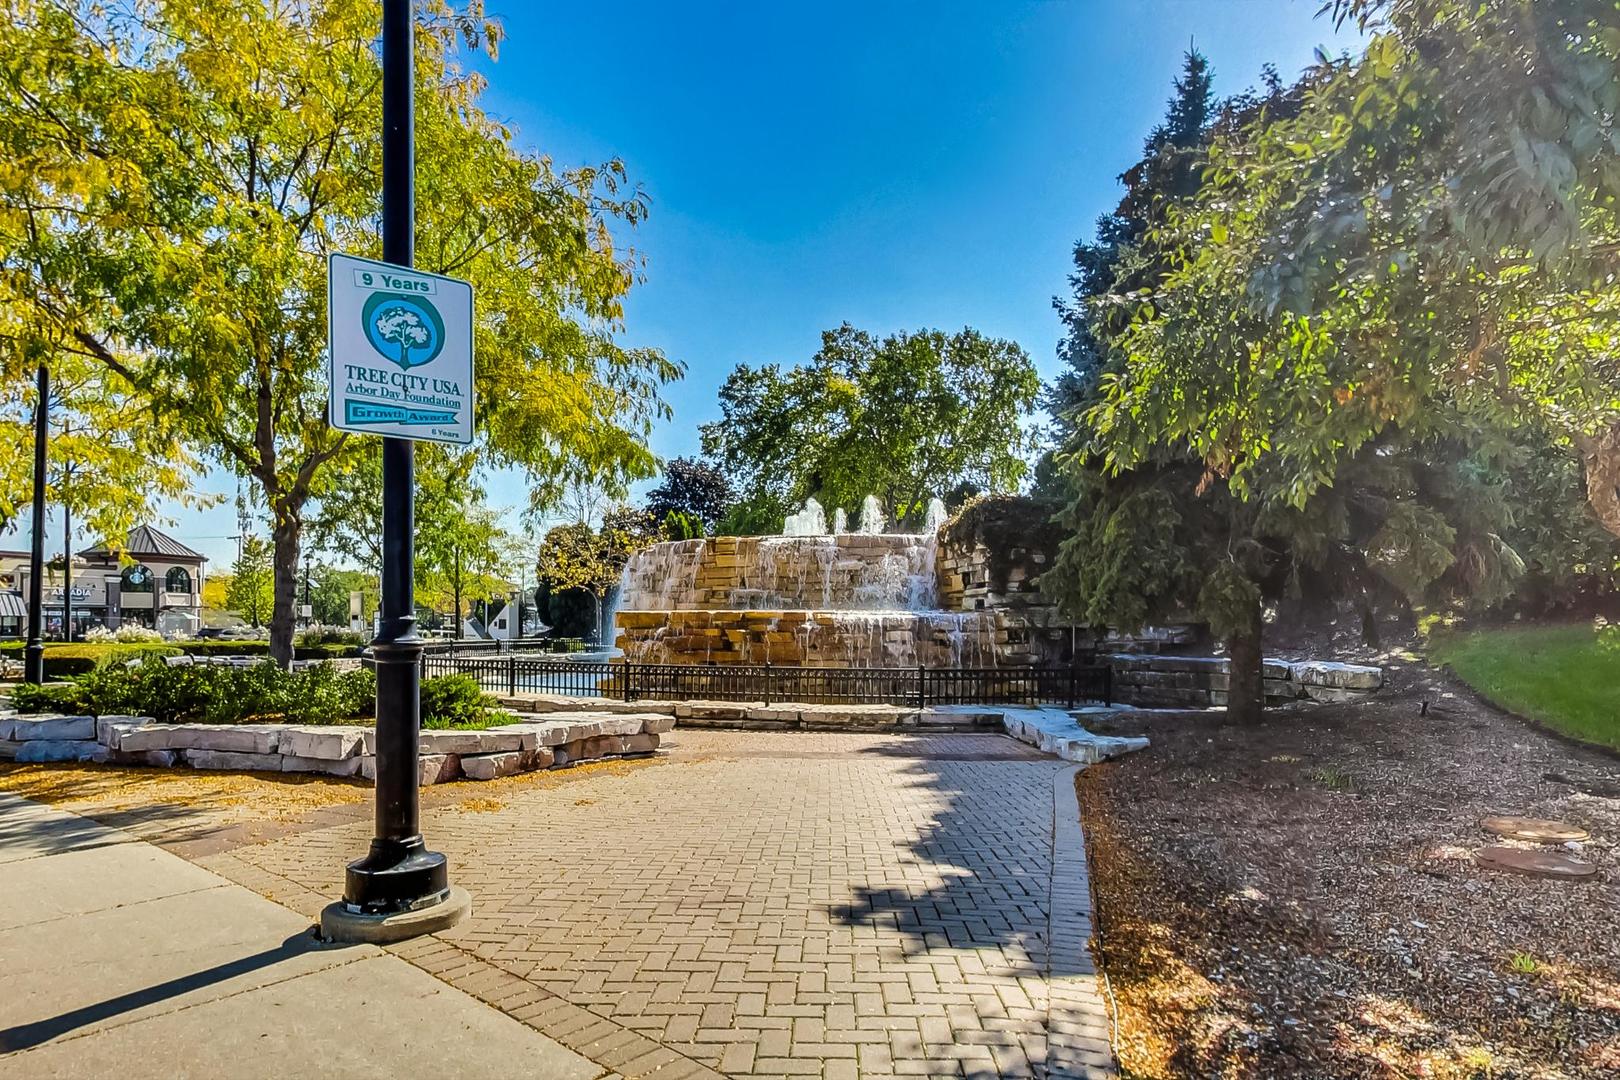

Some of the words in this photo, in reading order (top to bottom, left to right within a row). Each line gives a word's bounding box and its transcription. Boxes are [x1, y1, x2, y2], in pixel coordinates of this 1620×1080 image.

[362, 273, 373, 286] 9
[381, 275, 430, 292] Years
[345, 365, 389, 384] TREE
[391, 373, 428, 391] CITY
[345, 382, 378, 396] Arbor
[380, 387, 400, 401] Day
[404, 390, 461, 409] Foundation
[352, 406, 405, 418] Growth
[409, 413, 449, 421] Award
[438, 430, 459, 438] Years
[51, 588, 91, 596] ARADIA
